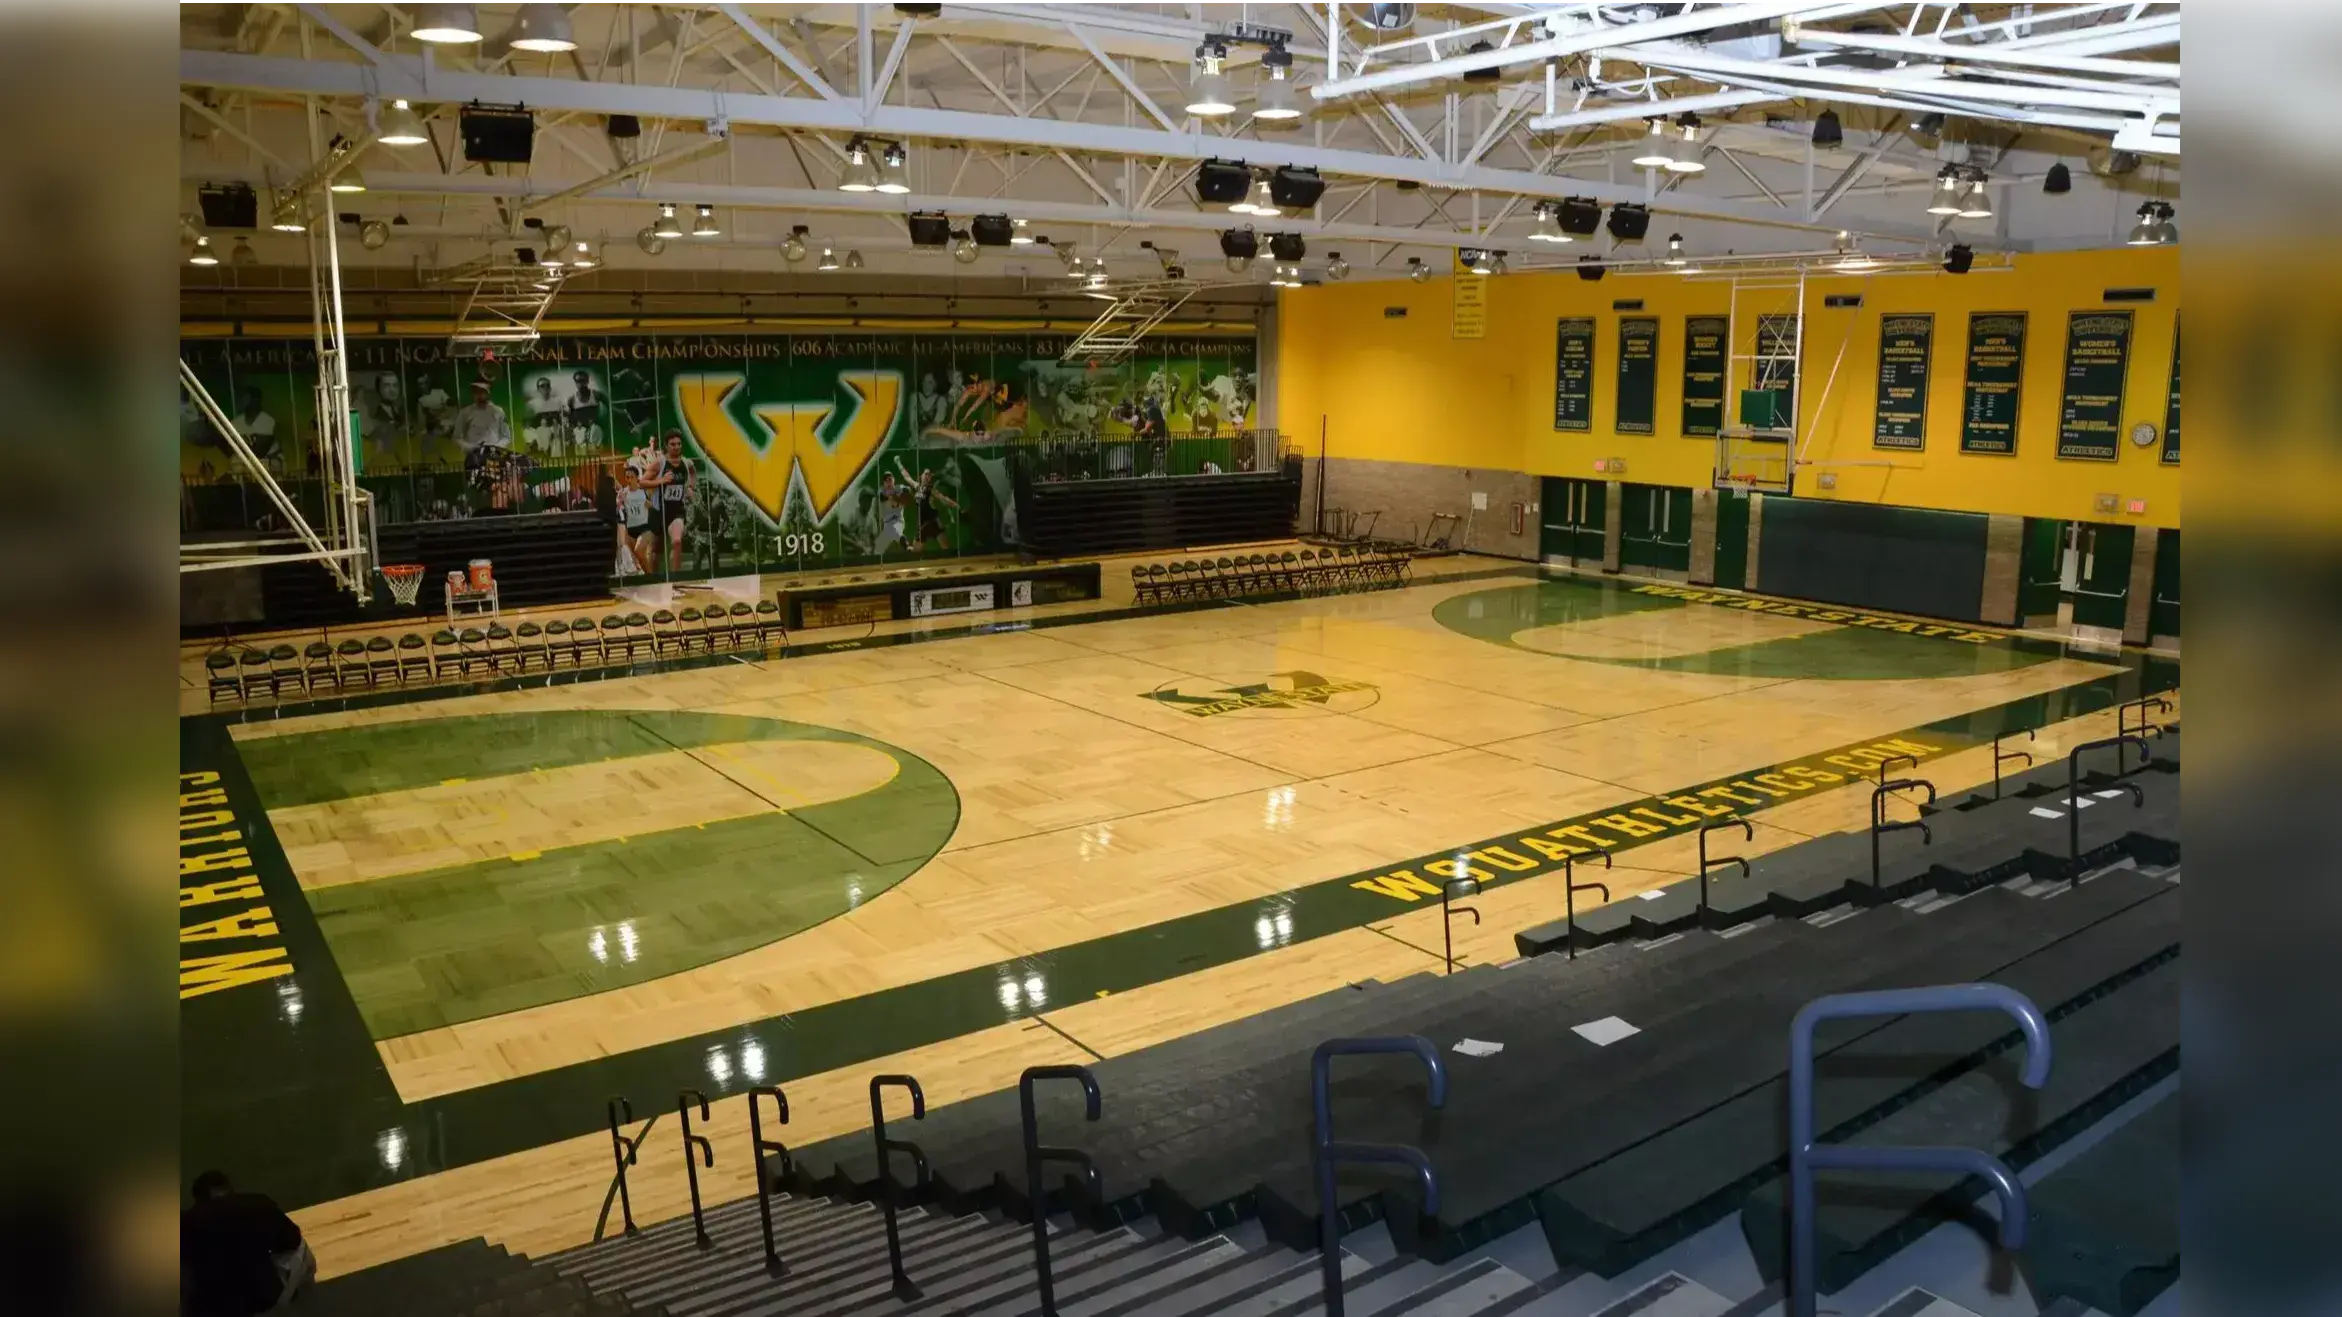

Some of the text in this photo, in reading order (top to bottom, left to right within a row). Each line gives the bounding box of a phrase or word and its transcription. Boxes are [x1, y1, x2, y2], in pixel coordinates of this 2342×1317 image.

[395, 345, 449, 364] NCA
[576, 344, 625, 360] TEAM
[632, 343, 781, 360] CHAMPIONSHIPS
[792, 341, 822, 356] 606
[825, 342, 905, 356] ACADEMIC
[1036, 341, 1054, 355] 83
[1180, 342, 1253, 356] CHAMPIONS
[773, 532, 825, 556] 1918
